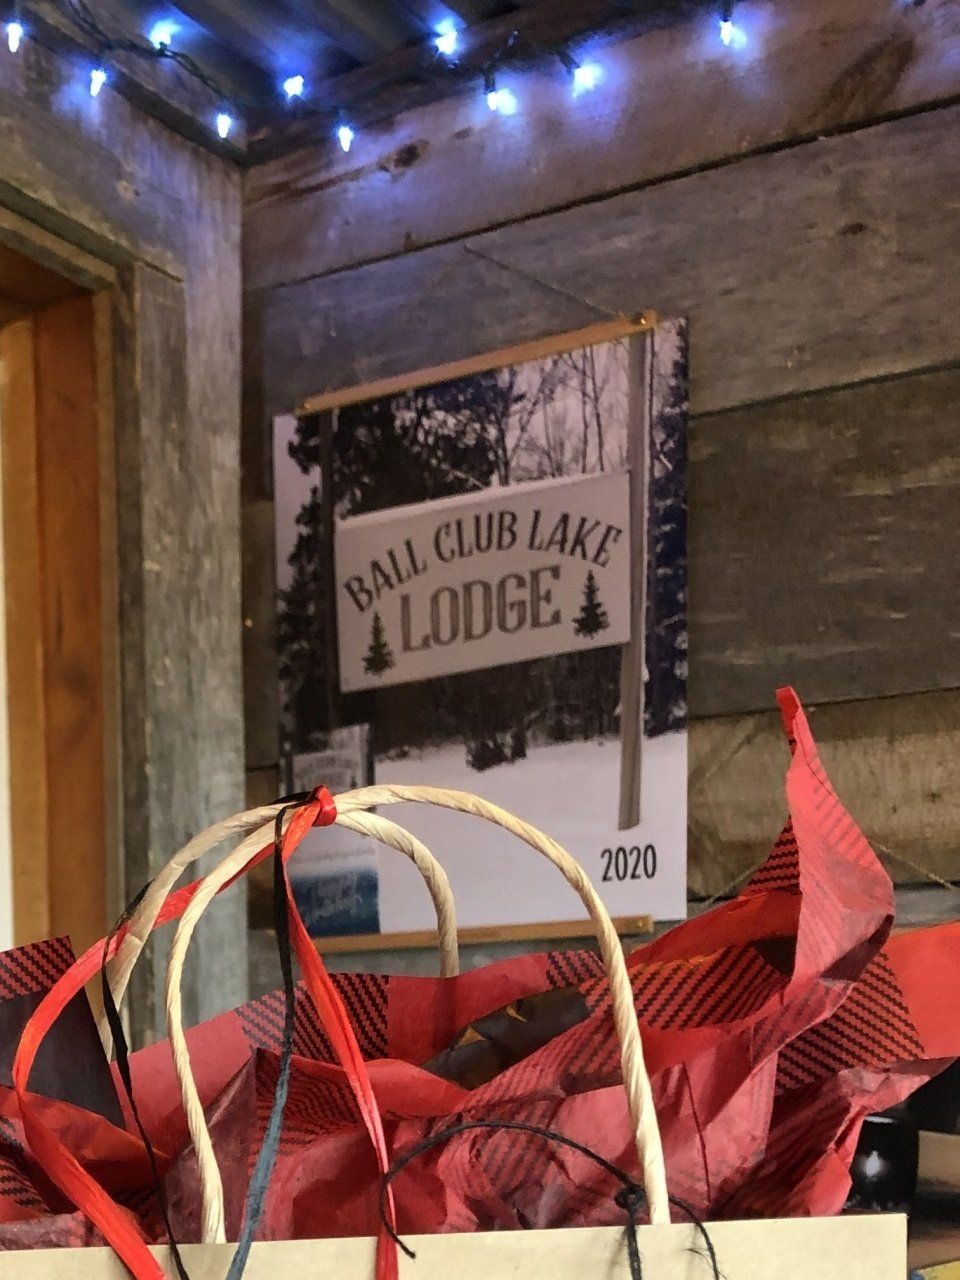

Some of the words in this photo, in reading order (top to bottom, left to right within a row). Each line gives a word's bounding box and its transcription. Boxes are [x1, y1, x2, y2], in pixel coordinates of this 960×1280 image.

[344, 536, 428, 612] BALL
[433, 510, 518, 563] CLUB
[528, 510, 623, 568] LAKE
[400, 564, 562, 651] LODGE
[600, 843, 657, 882] 2020
